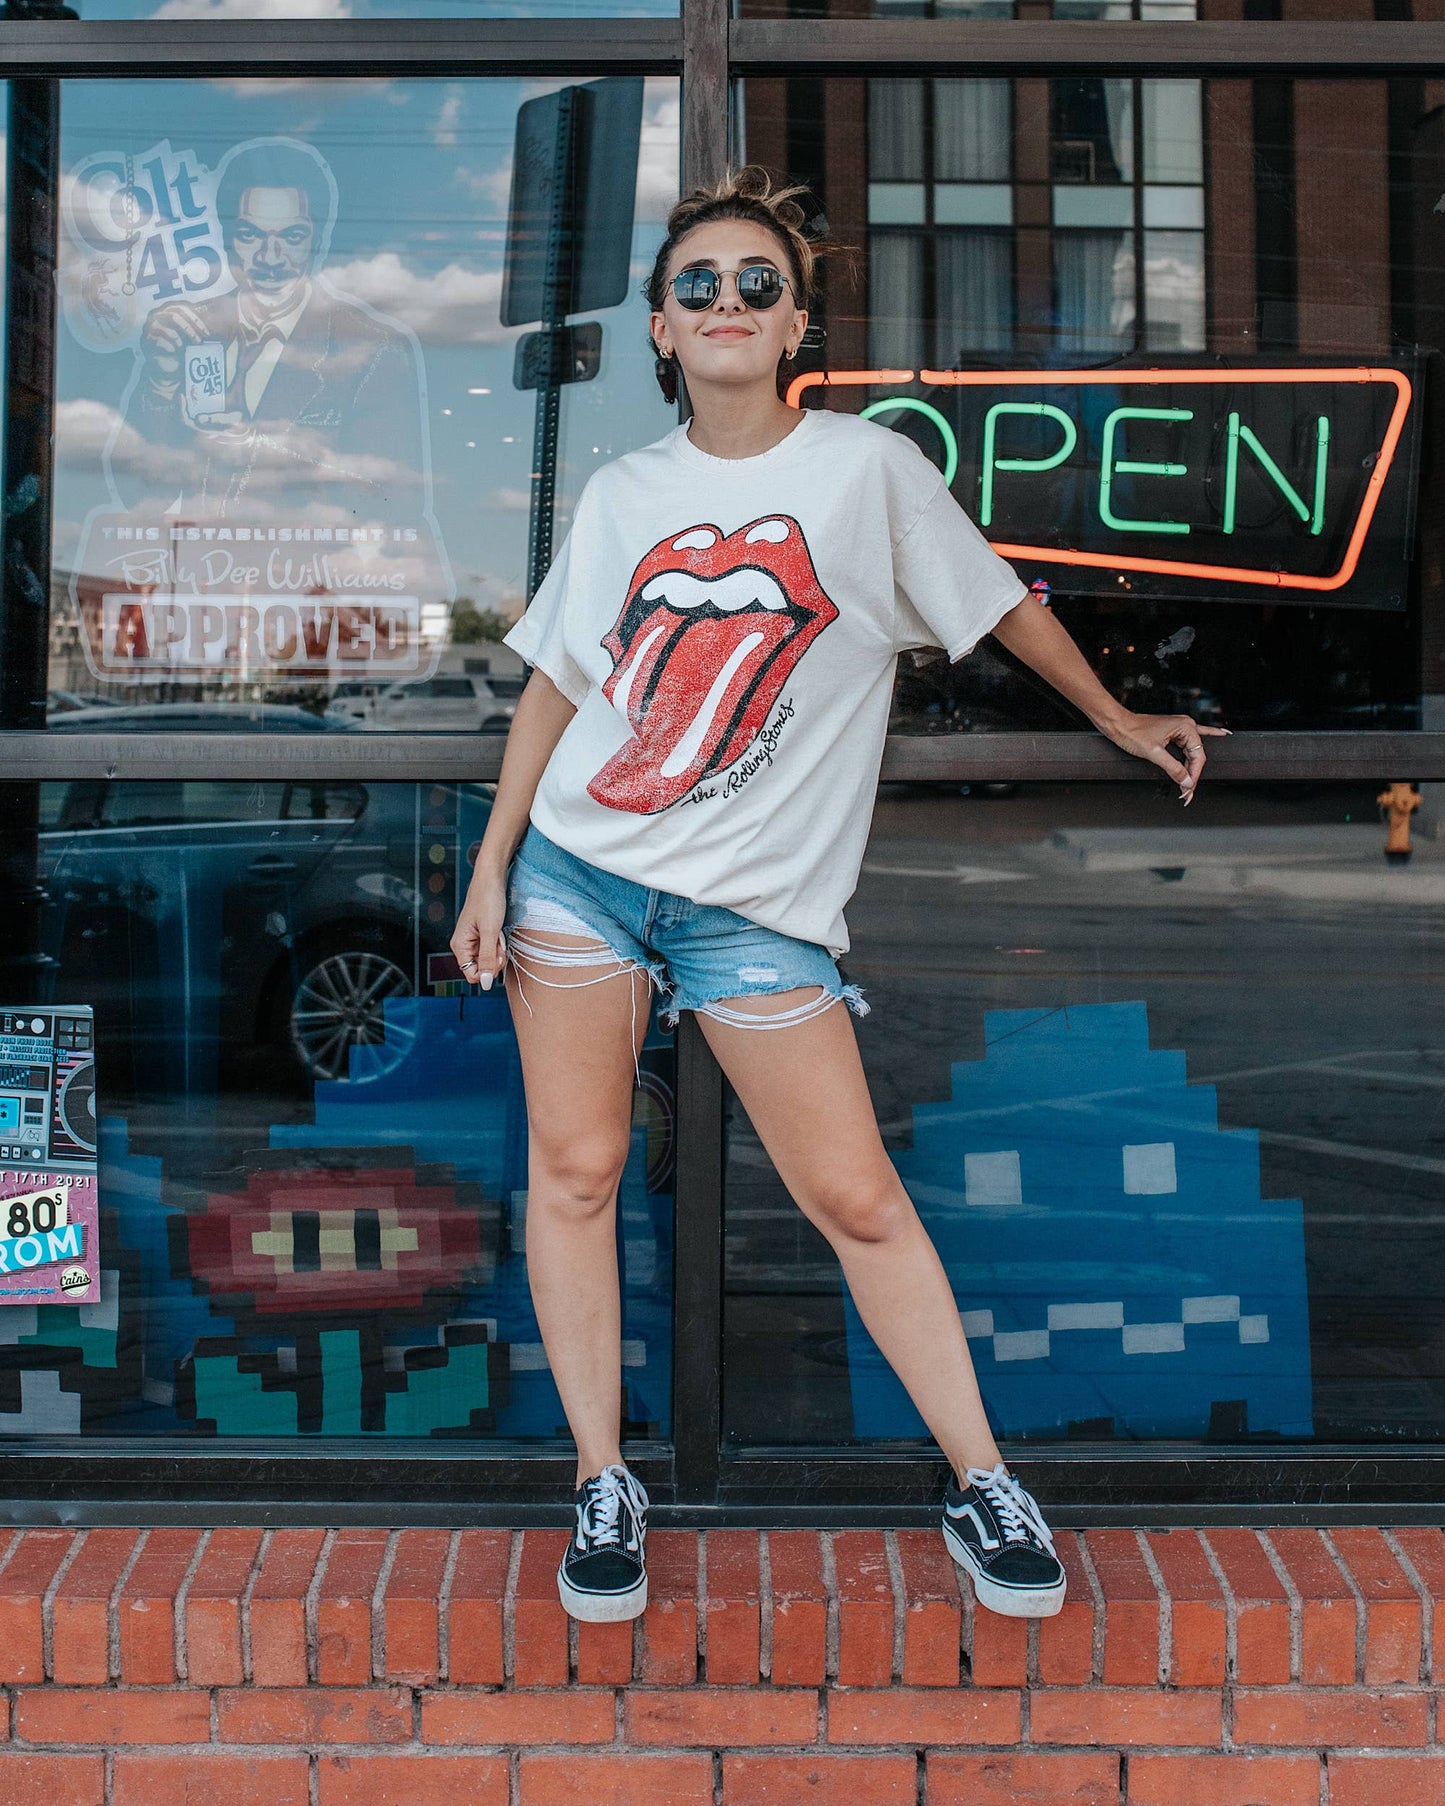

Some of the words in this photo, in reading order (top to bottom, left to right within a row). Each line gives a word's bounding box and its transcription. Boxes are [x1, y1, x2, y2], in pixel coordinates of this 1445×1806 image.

[72, 157, 207, 253] Colt
[136, 223, 222, 300] 45
[189, 356, 220, 384] Colt
[204, 375, 222, 396] 45
[103, 527, 160, 541] THIS
[169, 527, 384, 542] ESTABLISHMENT
[393, 528, 418, 542] IS
[105, 548, 200, 596] Billy
[200, 549, 259, 585] Dee
[267, 547, 407, 590] Williams
[113, 604, 409, 661] APPROVED
[680, 786, 718, 807] the
[723, 743, 773, 799] Rolling
[760, 698, 795, 752] Stones
[15, 1172, 48, 1186] 17TH
[57, 1175, 91, 1188] 2021
